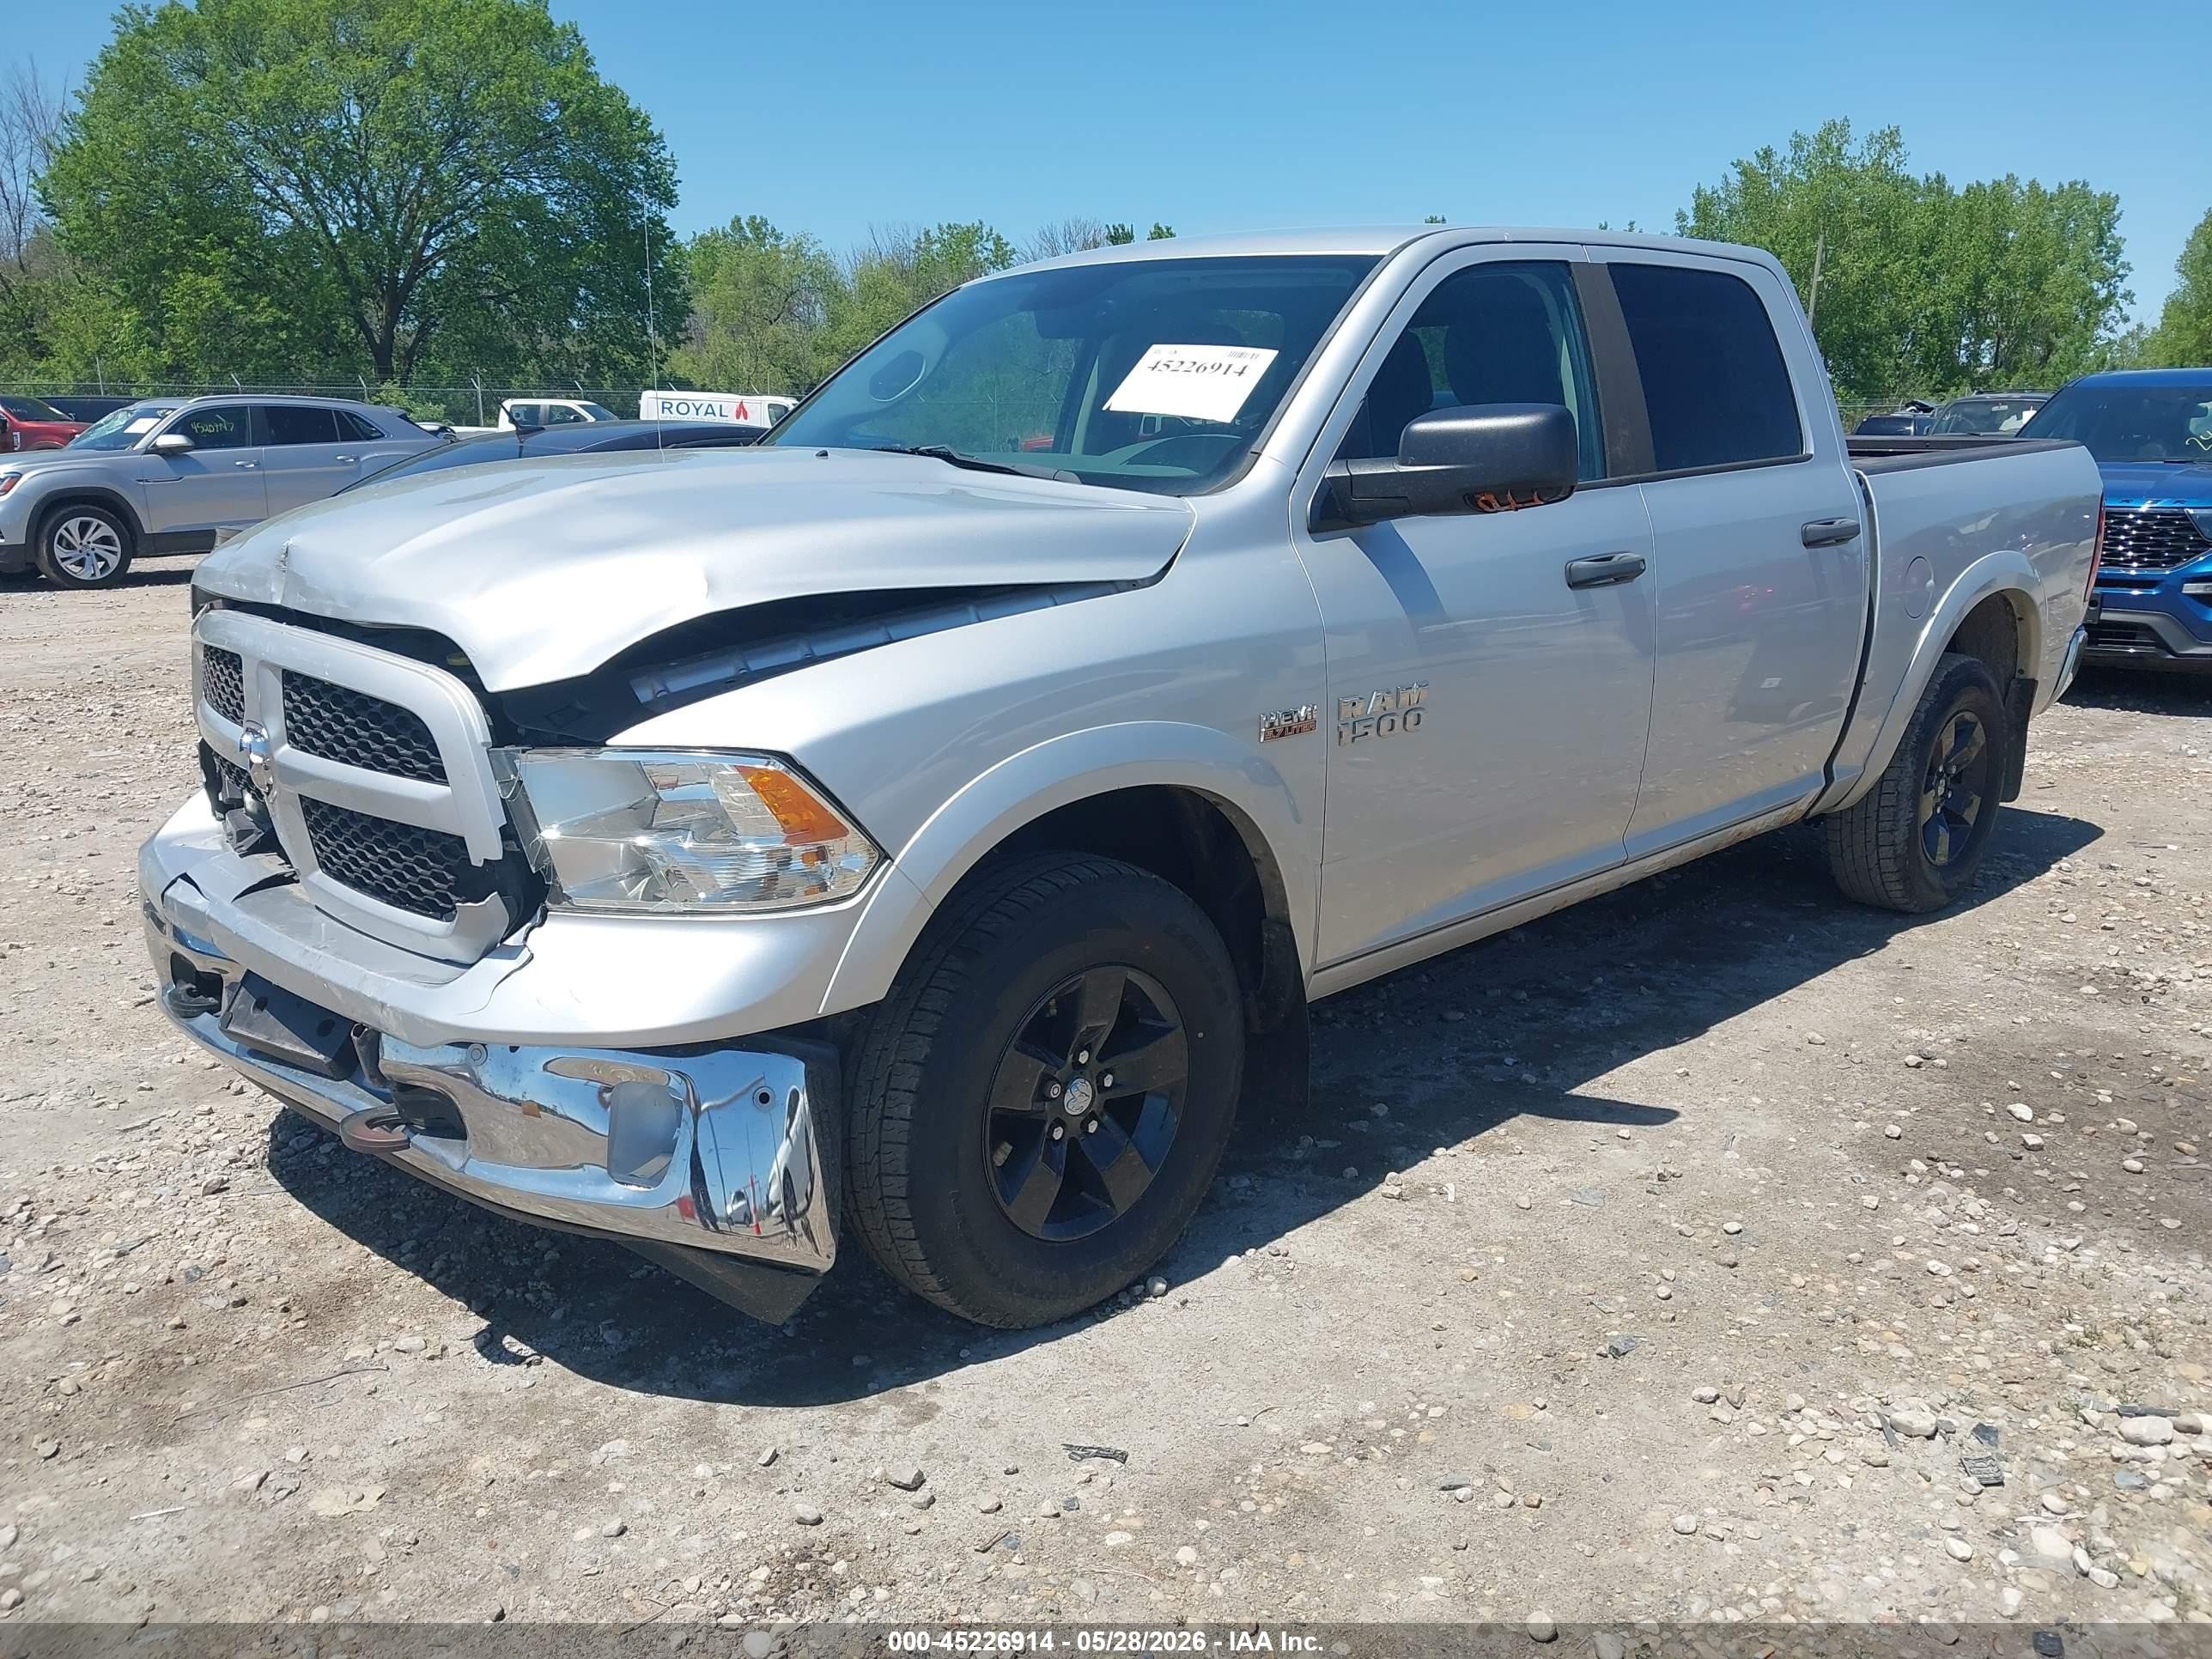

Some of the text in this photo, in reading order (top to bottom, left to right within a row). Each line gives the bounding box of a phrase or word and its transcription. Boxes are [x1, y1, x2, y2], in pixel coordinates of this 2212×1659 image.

[1147, 359, 1249, 377] 45226914
[661, 400, 729, 417] ROYAL
[1338, 681, 1429, 722] RAM
[1260, 704, 1318, 729] HEMI
[1338, 706, 1427, 747] 1500
[1265, 721, 1316, 741] 5.7 LITER
